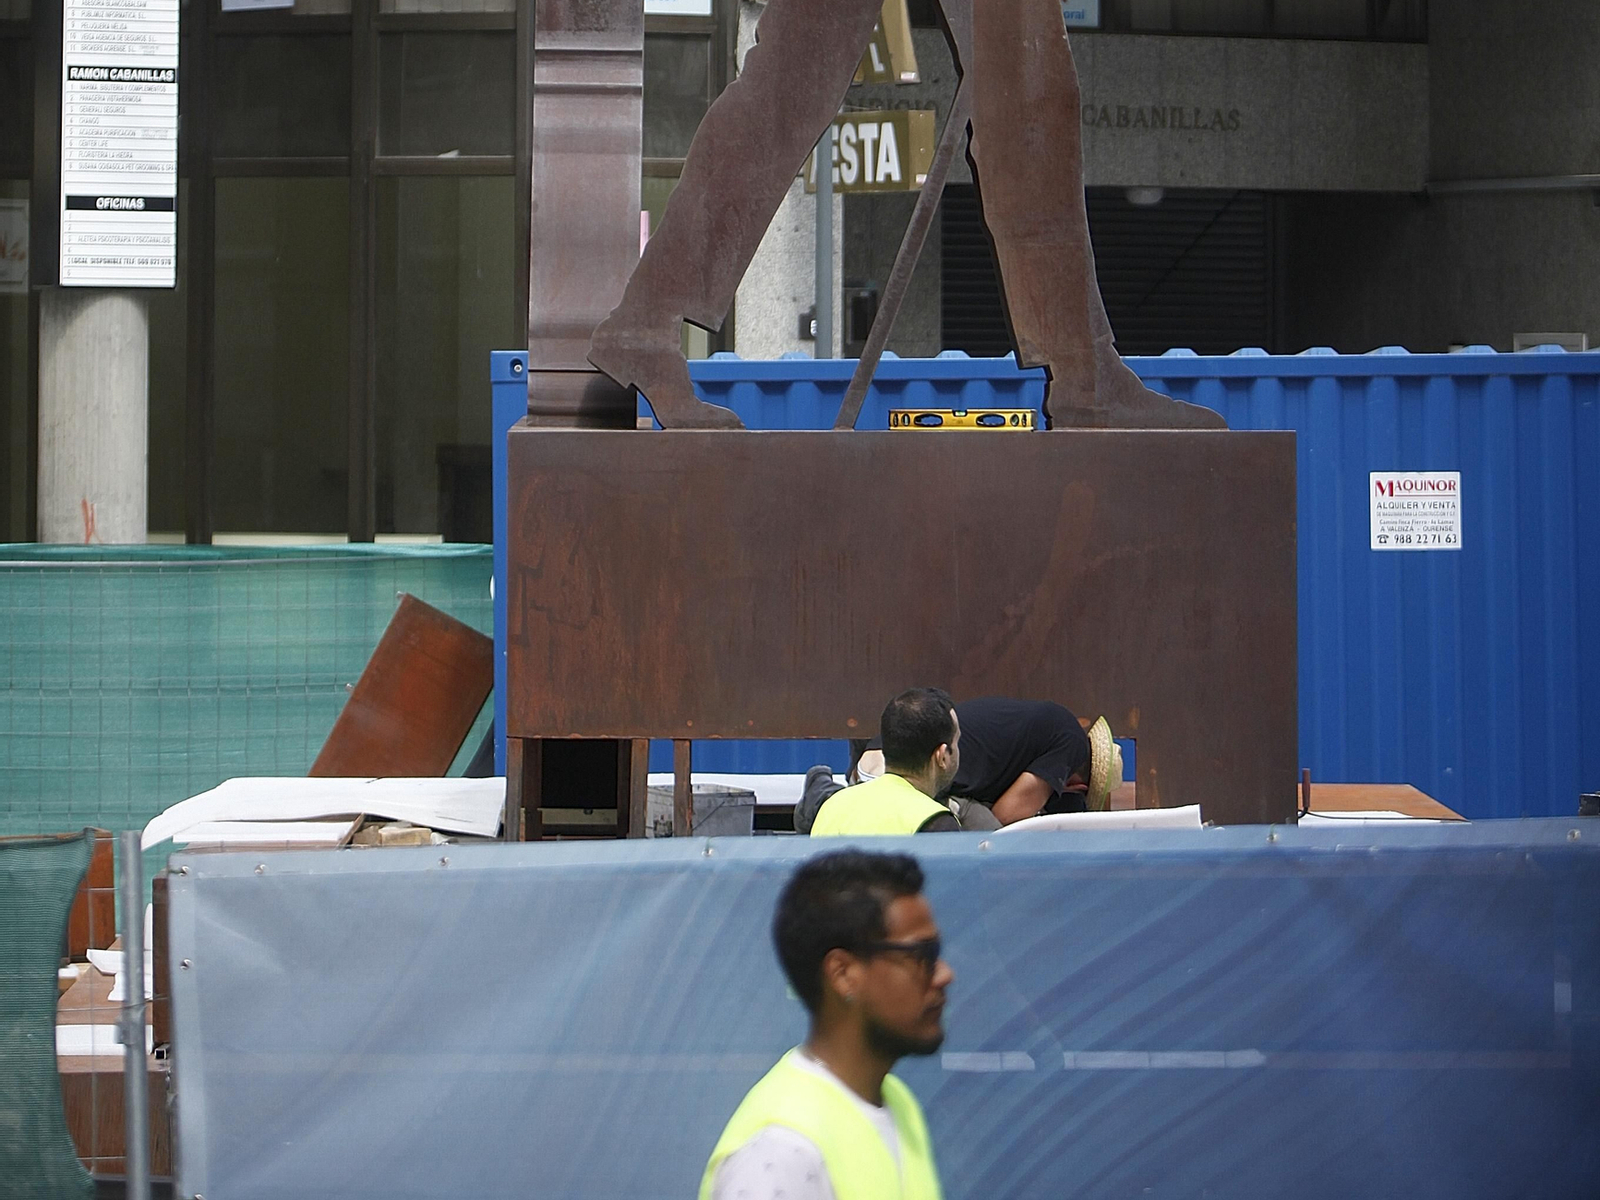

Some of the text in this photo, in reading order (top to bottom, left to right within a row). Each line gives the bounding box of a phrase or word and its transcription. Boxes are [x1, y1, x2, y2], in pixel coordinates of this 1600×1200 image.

[70, 67, 175, 82] RAMON CABANILLAS
[1082, 104, 1241, 132] CABANILLAS
[96, 197, 146, 210] OFICINAS
[1375, 480, 1456, 497] MAQUINOR
[1377, 501, 1456, 509] ALQUILER Y VENTA
[1394, 534, 1457, 544] 988 22 71 63
